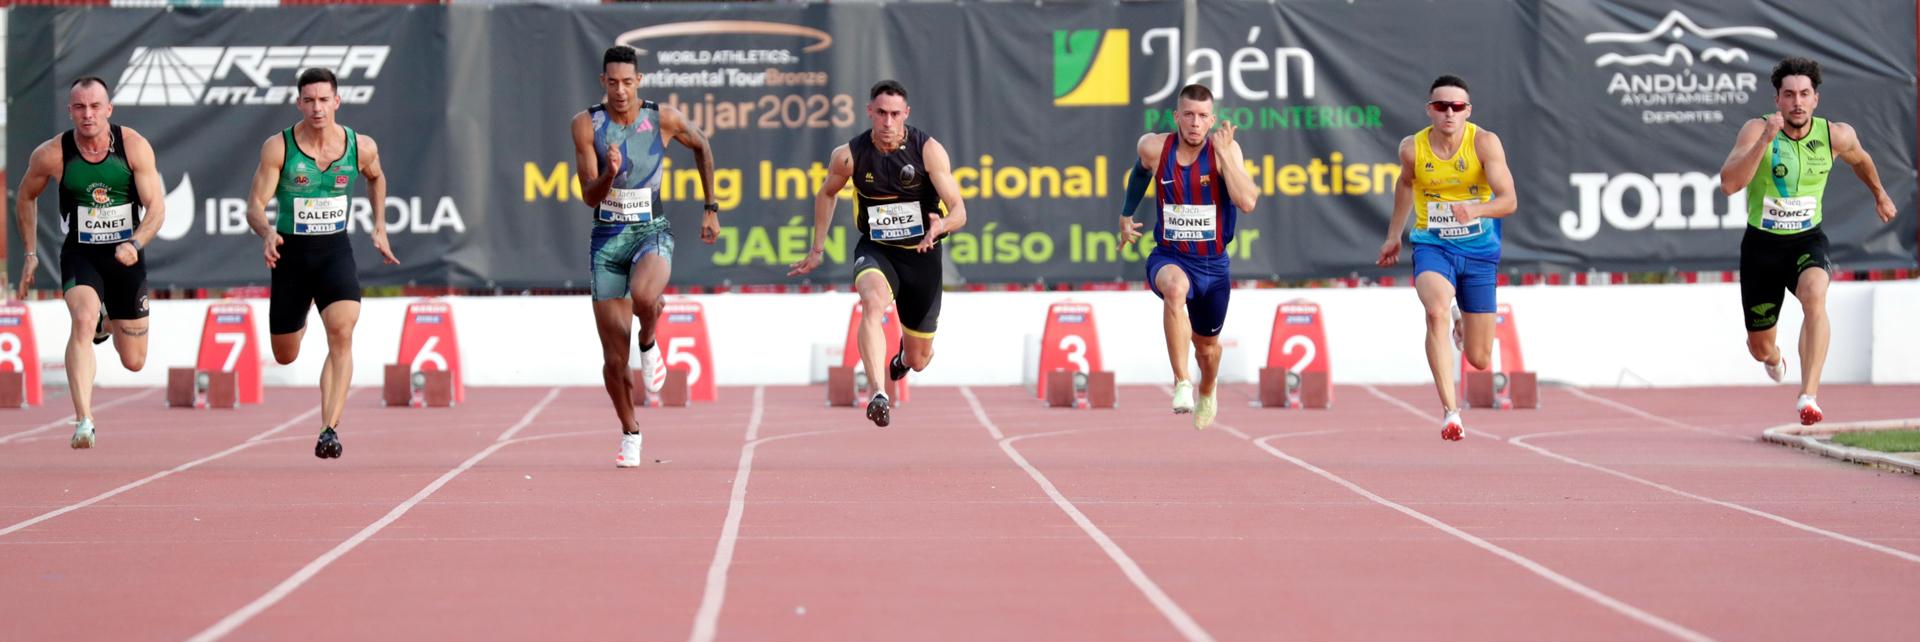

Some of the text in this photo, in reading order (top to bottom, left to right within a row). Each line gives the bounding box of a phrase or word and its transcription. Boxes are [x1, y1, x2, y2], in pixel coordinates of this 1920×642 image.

[657, 50, 790, 64] WORLD ATHLETICS
[1141, 26, 1315, 104] Jaén
[639, 69, 724, 87] ntinental
[1606, 68, 1757, 94] ANDÚJAR
[1621, 91, 1749, 106] AYUNTAMIENTO
[1143, 104, 1383, 130] PASO INTERIOR
[1642, 109, 1724, 124] DEPORTES
[524, 157, 743, 210] Ming
[759, 155, 1108, 200] Intcional
[298, 209, 344, 220] CALERO
[601, 199, 650, 209] RODRIGUES
[1559, 171, 1747, 241] Jom
[1769, 208, 1810, 218] GOMEZ
[85, 218, 126, 229] CANET
[876, 214, 914, 226] LOPEZ
[1168, 217, 1211, 227] MONNE
[1429, 215, 1457, 223] MONT
[712, 216, 847, 266] JAÉN
[945, 222, 1055, 265] aíso
[214, 332, 246, 373] 7
[411, 335, 449, 375] 6
[666, 336, 702, 386] 5
[1058, 334, 1091, 374] 3
[1281, 334, 1318, 373] 2
